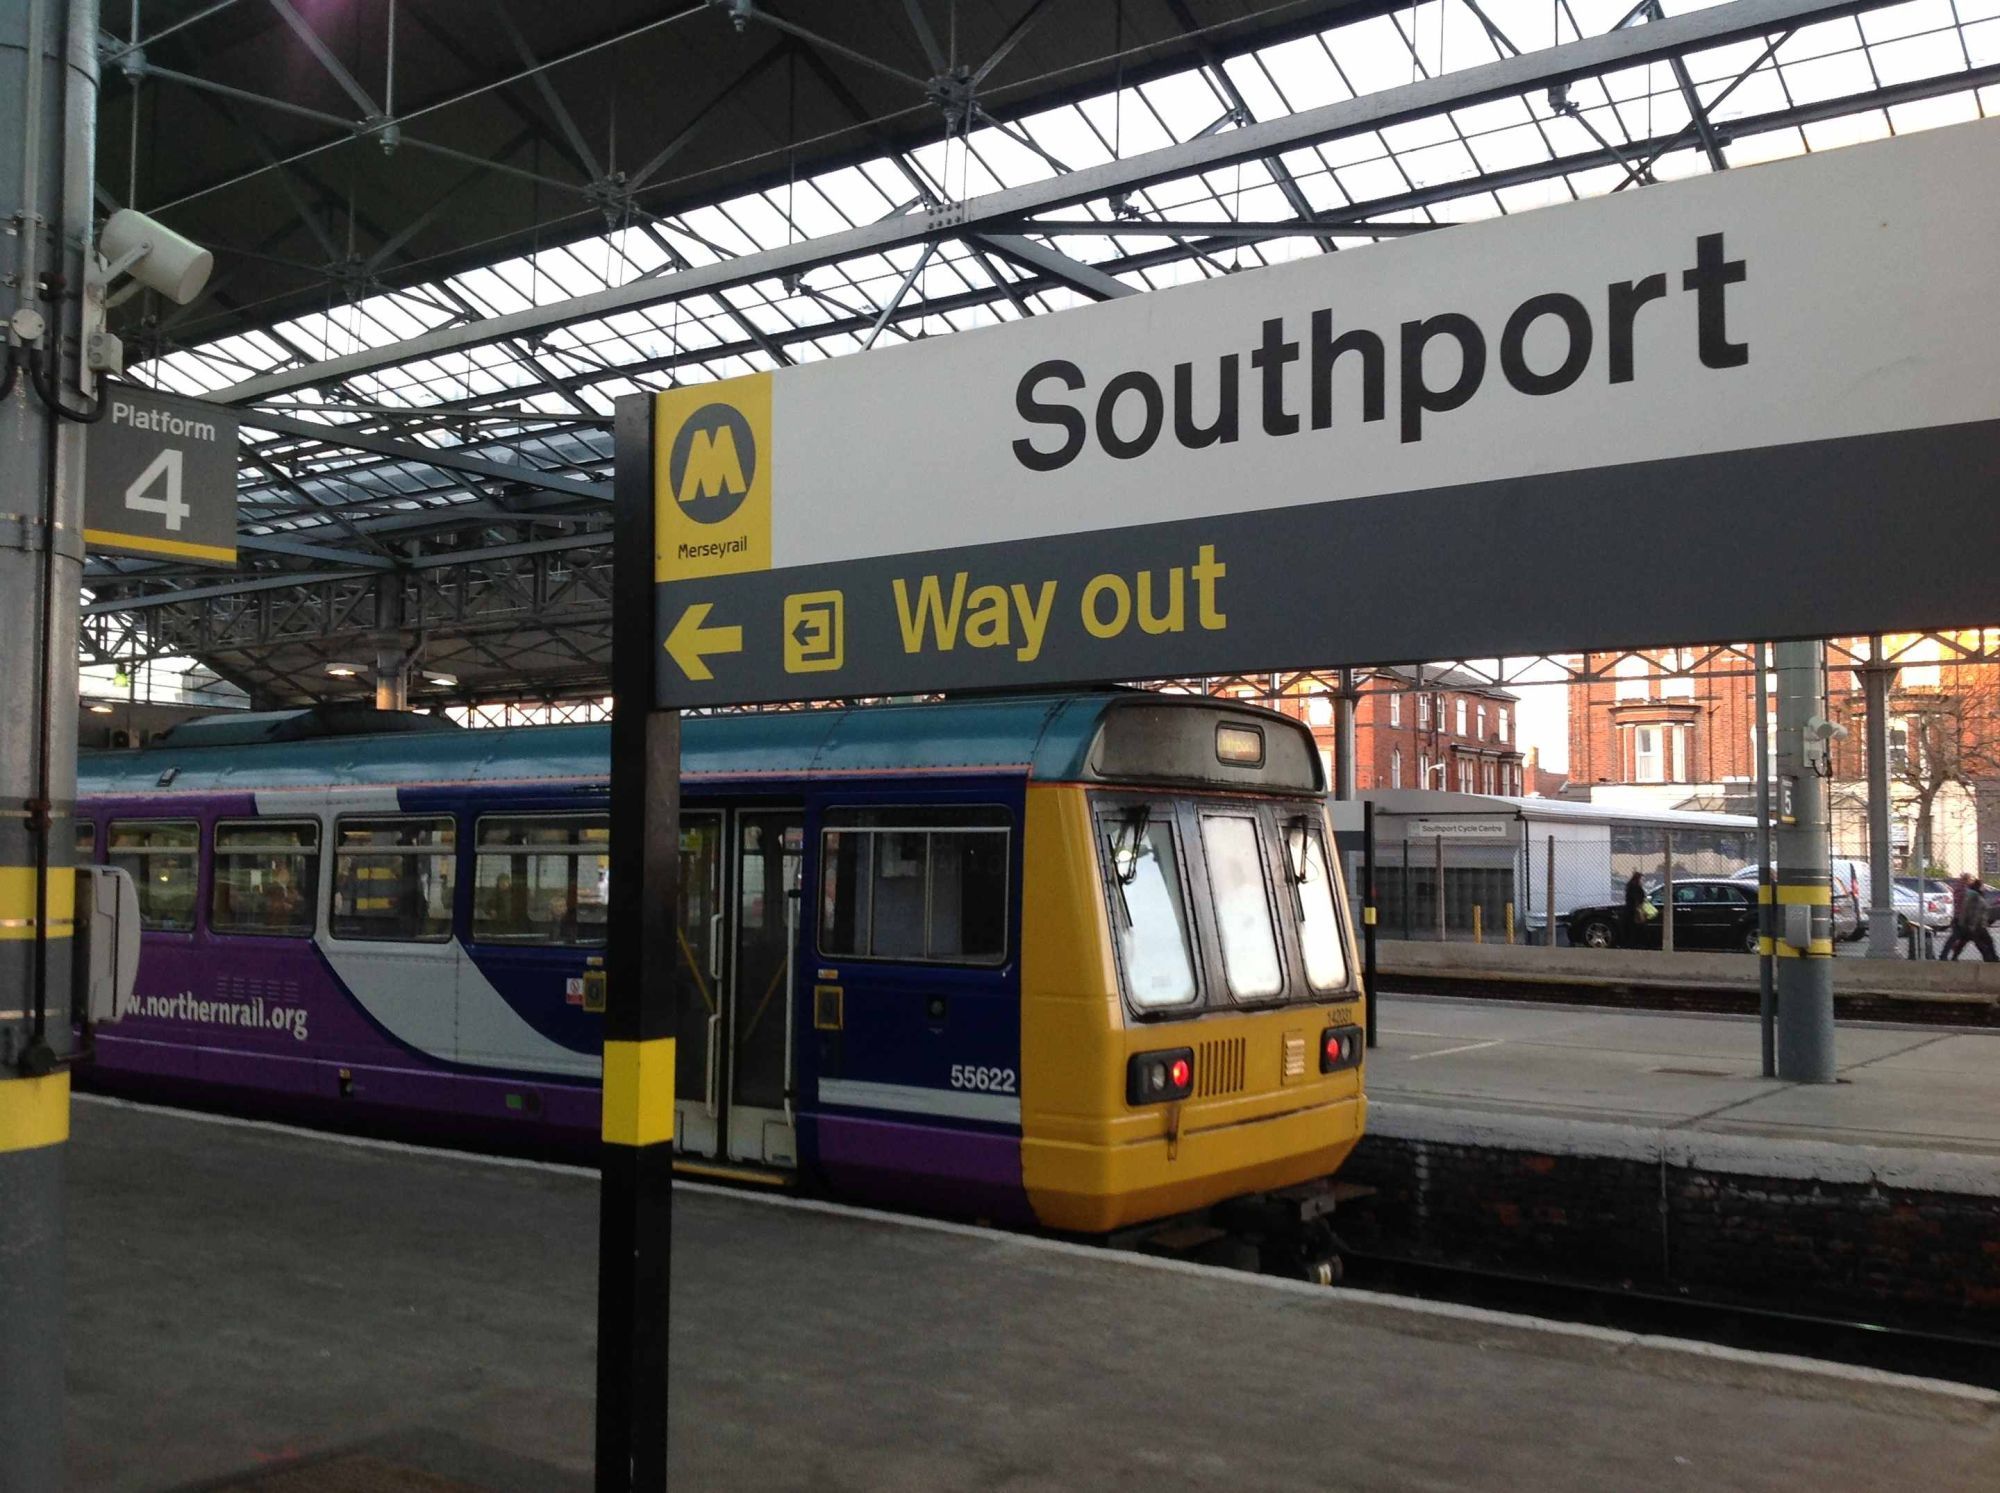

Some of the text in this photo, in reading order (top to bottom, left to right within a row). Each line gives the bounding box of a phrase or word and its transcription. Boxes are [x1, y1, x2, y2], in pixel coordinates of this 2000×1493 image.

[1012, 231, 1749, 472] Southport
[112, 402, 216, 441] Platform
[678, 425, 747, 502] M
[125, 449, 190, 531] 4
[678, 536, 748, 559] Merseyrail
[892, 544, 1226, 662] Way out
[1784, 790, 1792, 815] 5
[1422, 824, 1503, 833] Southport Cycle Centre
[951, 1064, 1016, 1093] 55622
